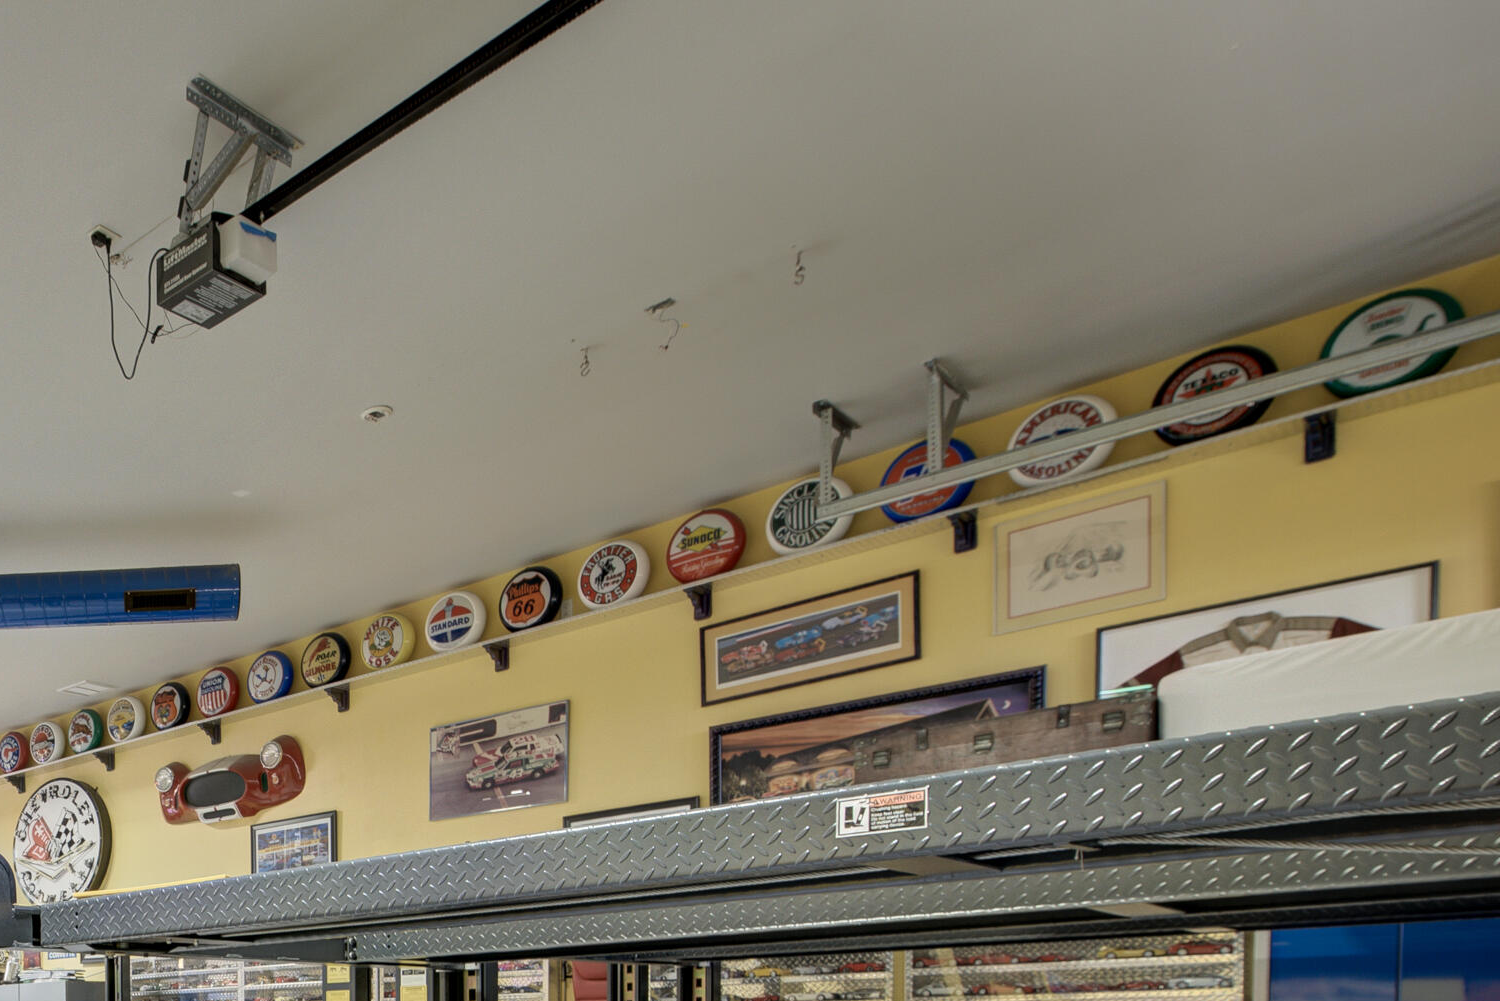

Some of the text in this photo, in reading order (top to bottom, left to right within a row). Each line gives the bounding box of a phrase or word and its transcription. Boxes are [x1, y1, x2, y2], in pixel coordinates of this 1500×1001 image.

[1183, 368, 1239, 390] TEXACO
[681, 528, 721, 549] SUNOCO
[583, 546, 636, 577] FRONTIER
[595, 587, 624, 604] GAS
[513, 598, 535, 617] 66
[364, 615, 399, 641] WHITE
[430, 616, 470, 633] STANDARD
[202, 675, 223, 688] UNION
[880, 793, 923, 805] WARNING
[15, 785, 95, 842] CHEVROLET
